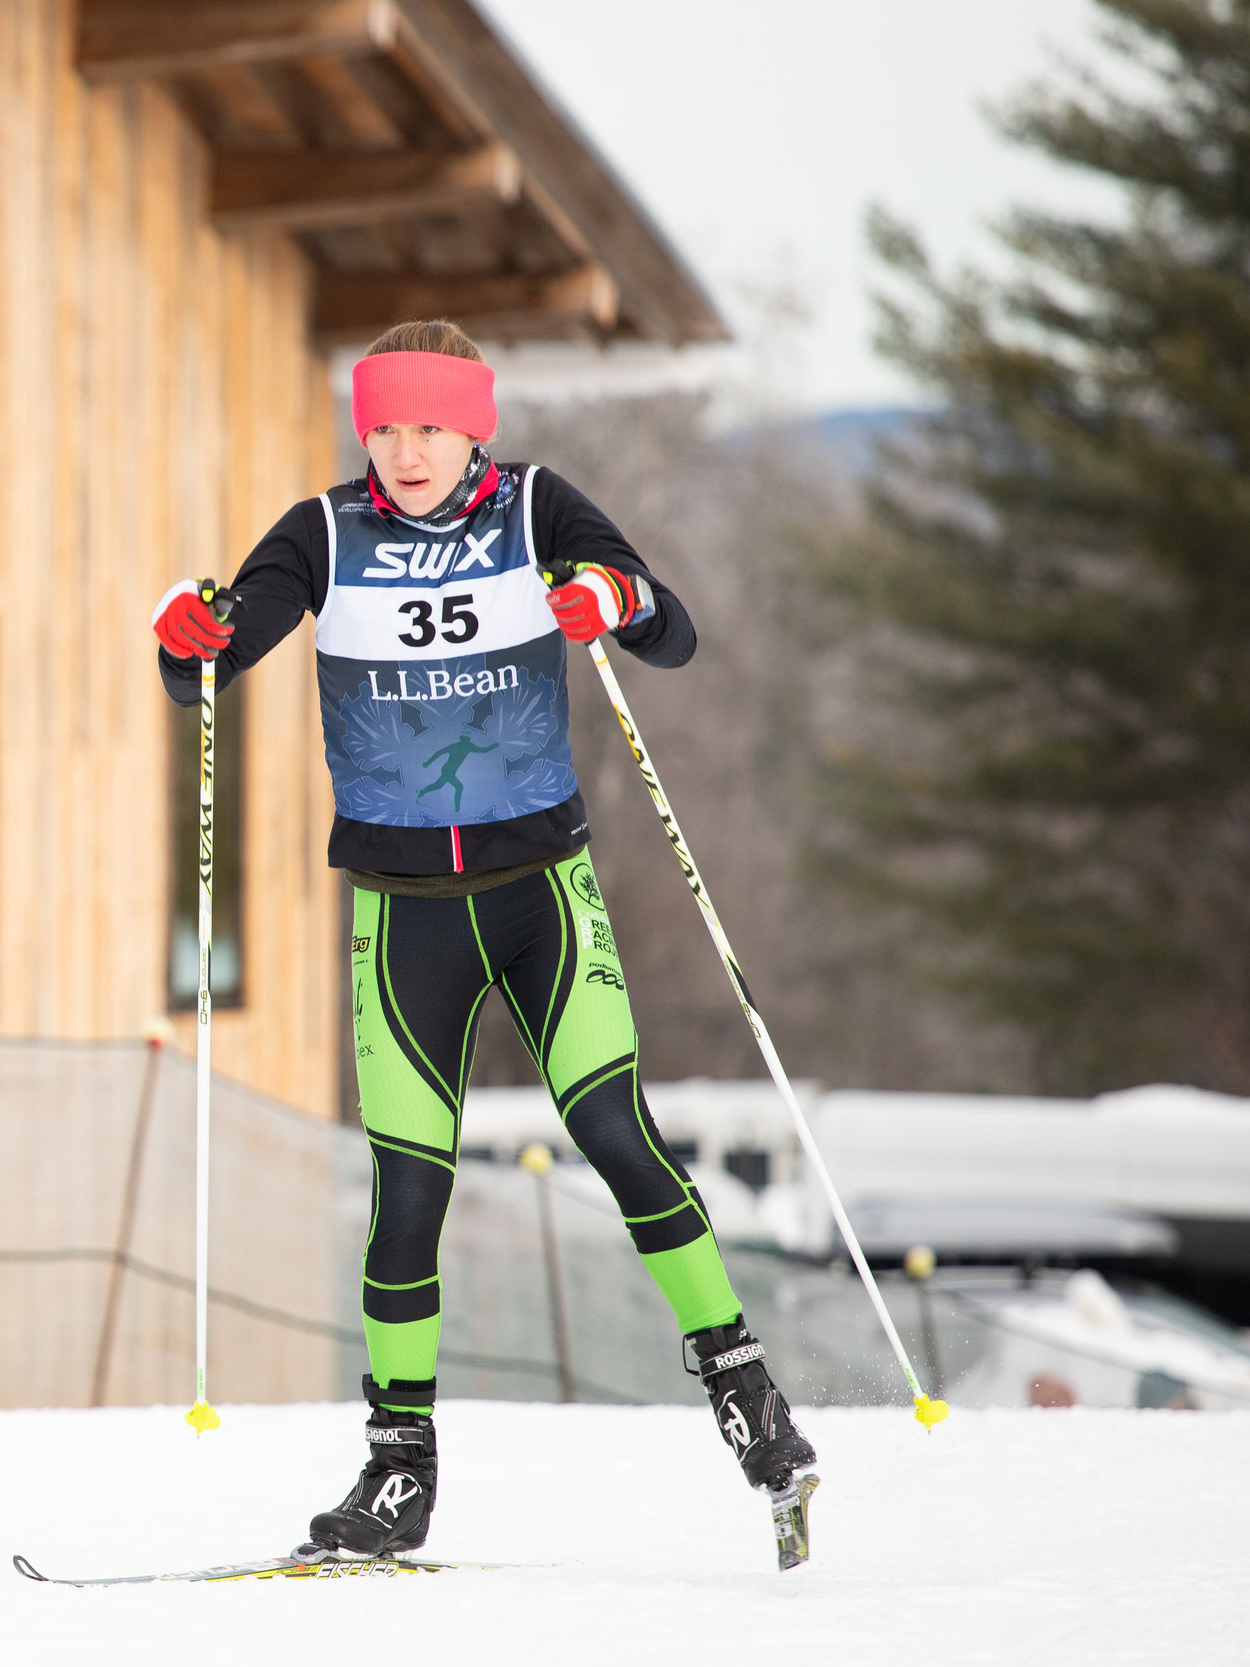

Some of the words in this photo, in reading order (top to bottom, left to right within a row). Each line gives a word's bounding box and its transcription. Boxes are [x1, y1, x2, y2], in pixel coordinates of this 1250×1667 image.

[362, 529, 502, 579] SWIX
[397, 594, 479, 647] 35
[367, 664, 519, 701] L.L.Bean
[199, 802, 214, 895] WAY
[583, 938, 618, 957] PROJ
